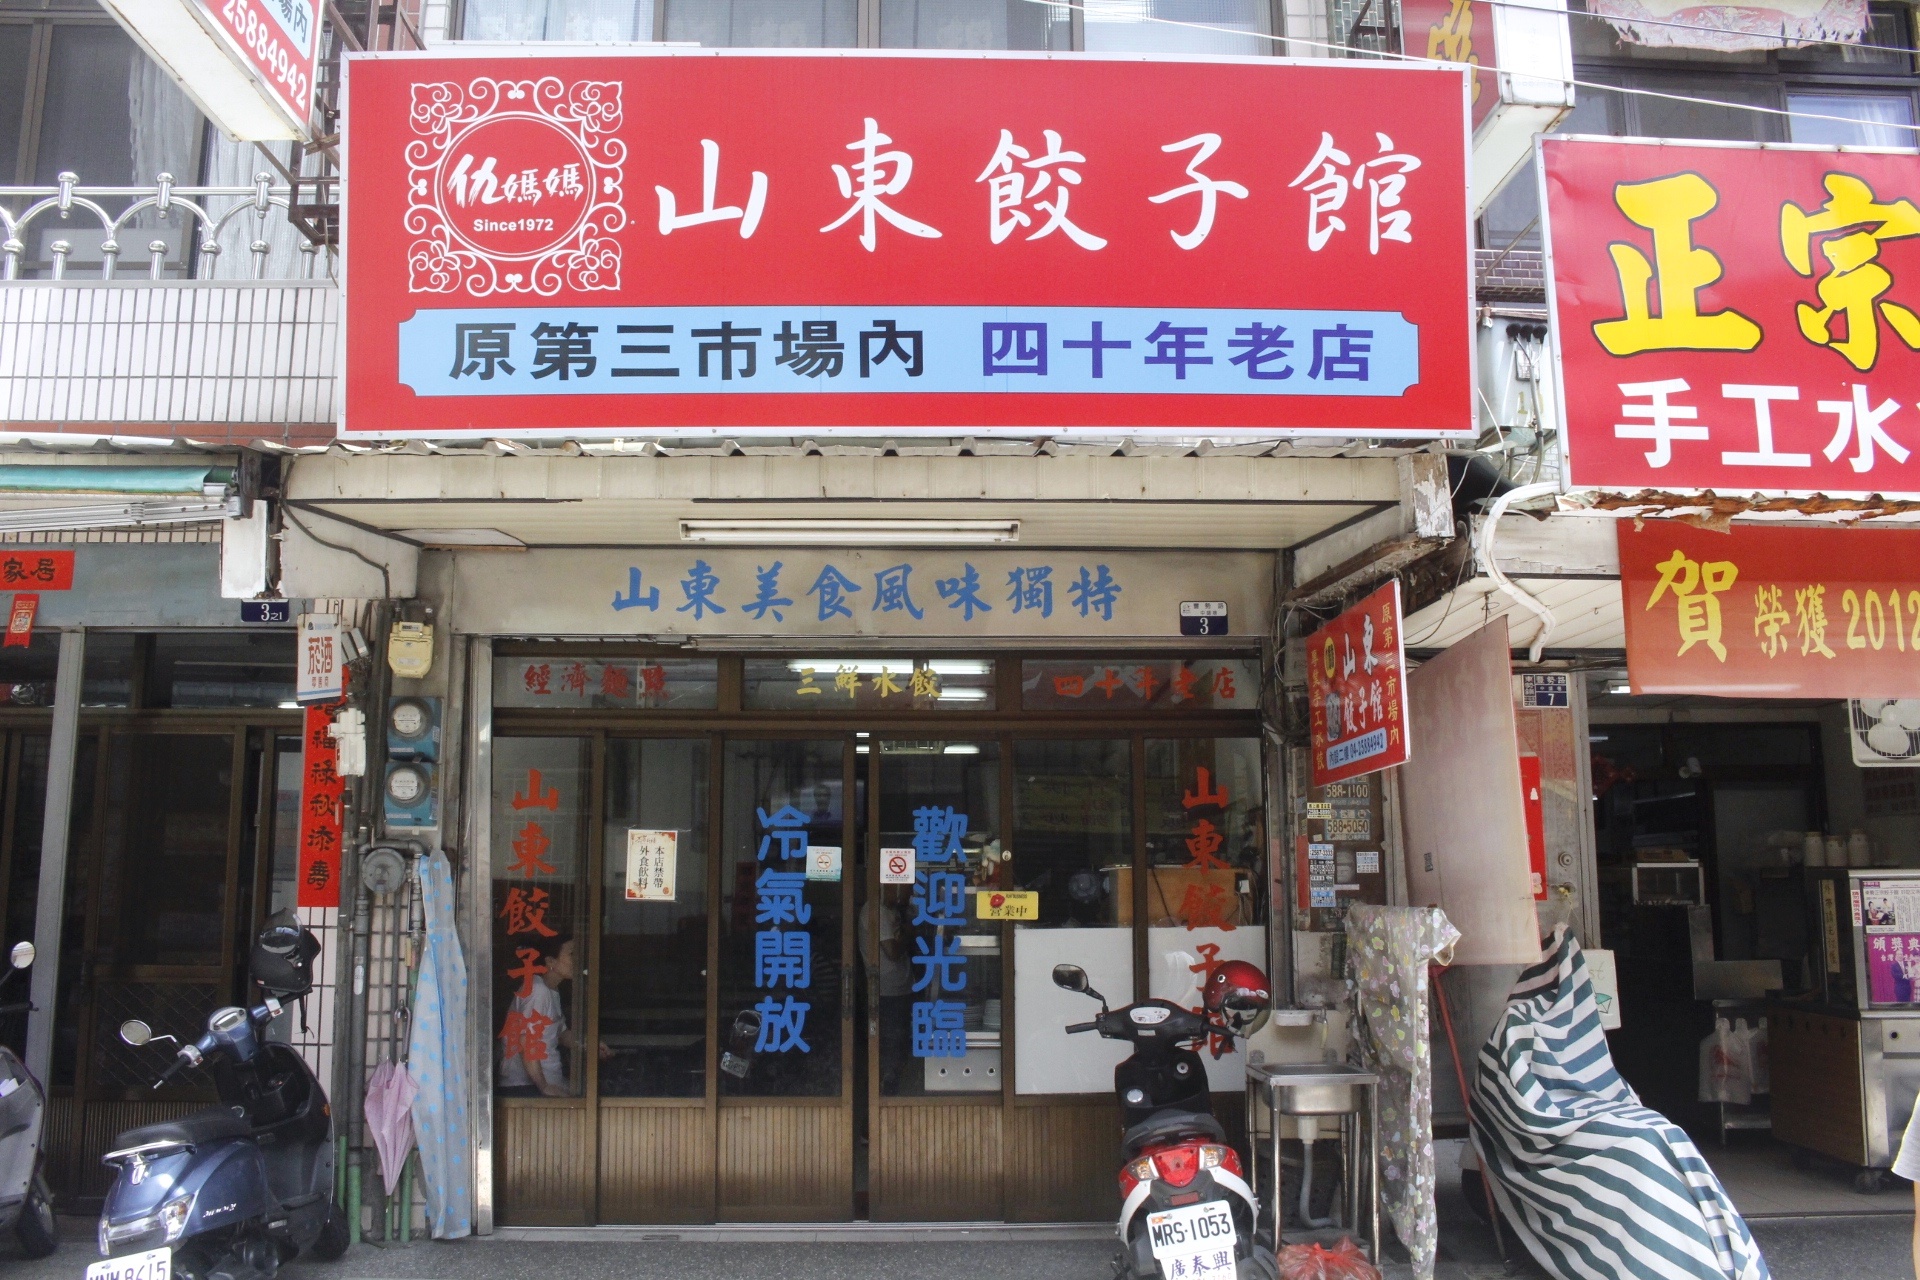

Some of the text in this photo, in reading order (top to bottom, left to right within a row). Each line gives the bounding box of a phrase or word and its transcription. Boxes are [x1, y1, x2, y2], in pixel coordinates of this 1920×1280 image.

[655, 117, 1422, 255] 山東餃子館
[473, 218, 554, 232] Since1972
[1593, 171, 1920, 371] 正宗
[448, 320, 1375, 383] 原第三市場內 四十年老店
[1614, 378, 1920, 474] 手工水
[611, 559, 1122, 622] 山東美食風味獨特
[1646, 549, 1739, 663] 賀
[1200, 617, 1209, 635] 3
[1342, 613, 1379, 681] 山東
[796, 664, 943, 699] 三鮮水餃
[1053, 666, 1237, 701] 四十年老店
[1381, 602, 1400, 746] 原第三市場內
[1548, 693, 1555, 706] 7
[1343, 679, 1384, 735] 餃子館
[638, 845, 650, 890] 外食飲料
[653, 846, 665, 889] 本店禁帶
[500, 768, 559, 1062] 山東餃子館
[755, 804, 812, 1053] 冷氣開放
[911, 805, 968, 1058] 歡迎光臨
